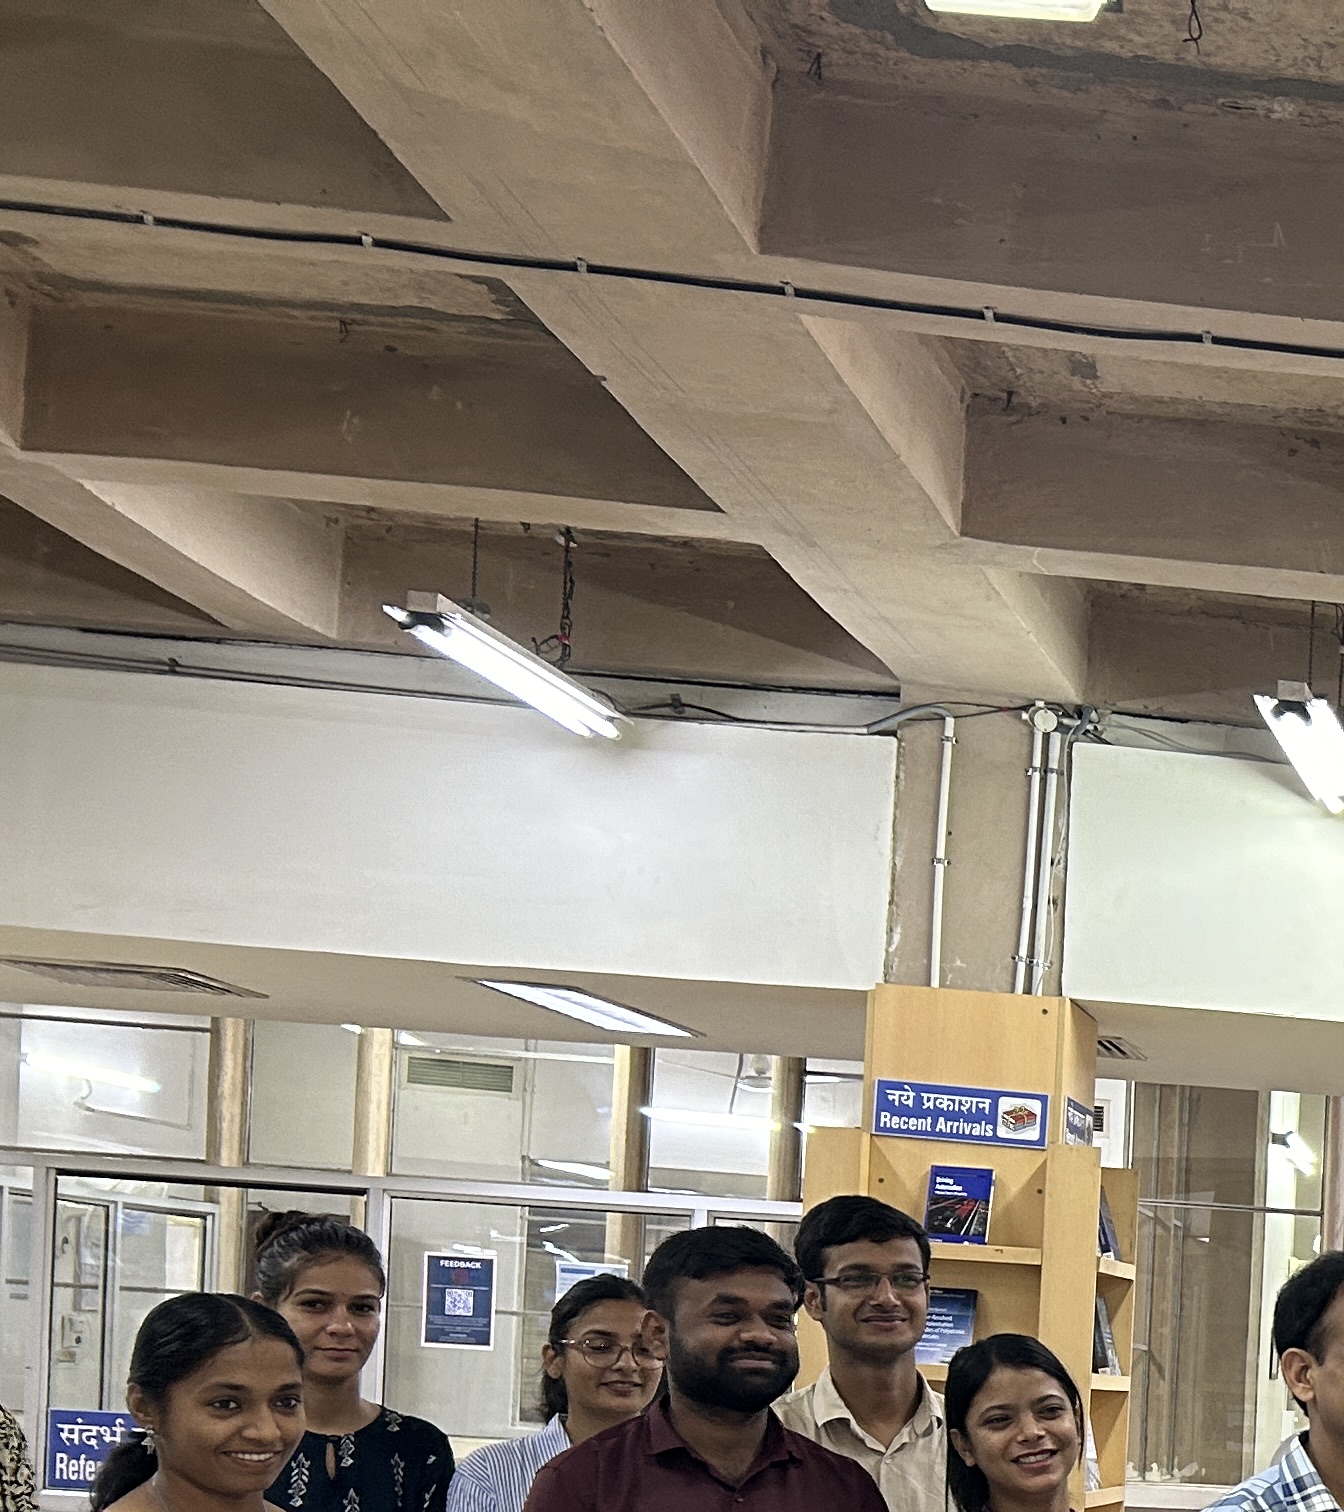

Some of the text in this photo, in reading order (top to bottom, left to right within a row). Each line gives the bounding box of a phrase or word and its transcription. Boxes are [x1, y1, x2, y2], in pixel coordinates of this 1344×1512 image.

[886, 1085, 991, 1115] नये प्रकाशन
[880, 1111, 993, 1137] Recent Arrivals
[440, 1260, 482, 1269] FEEDBACK
[56, 1418, 126, 1450] संदर्भ
[55, 1452, 102, 1480] Refe
